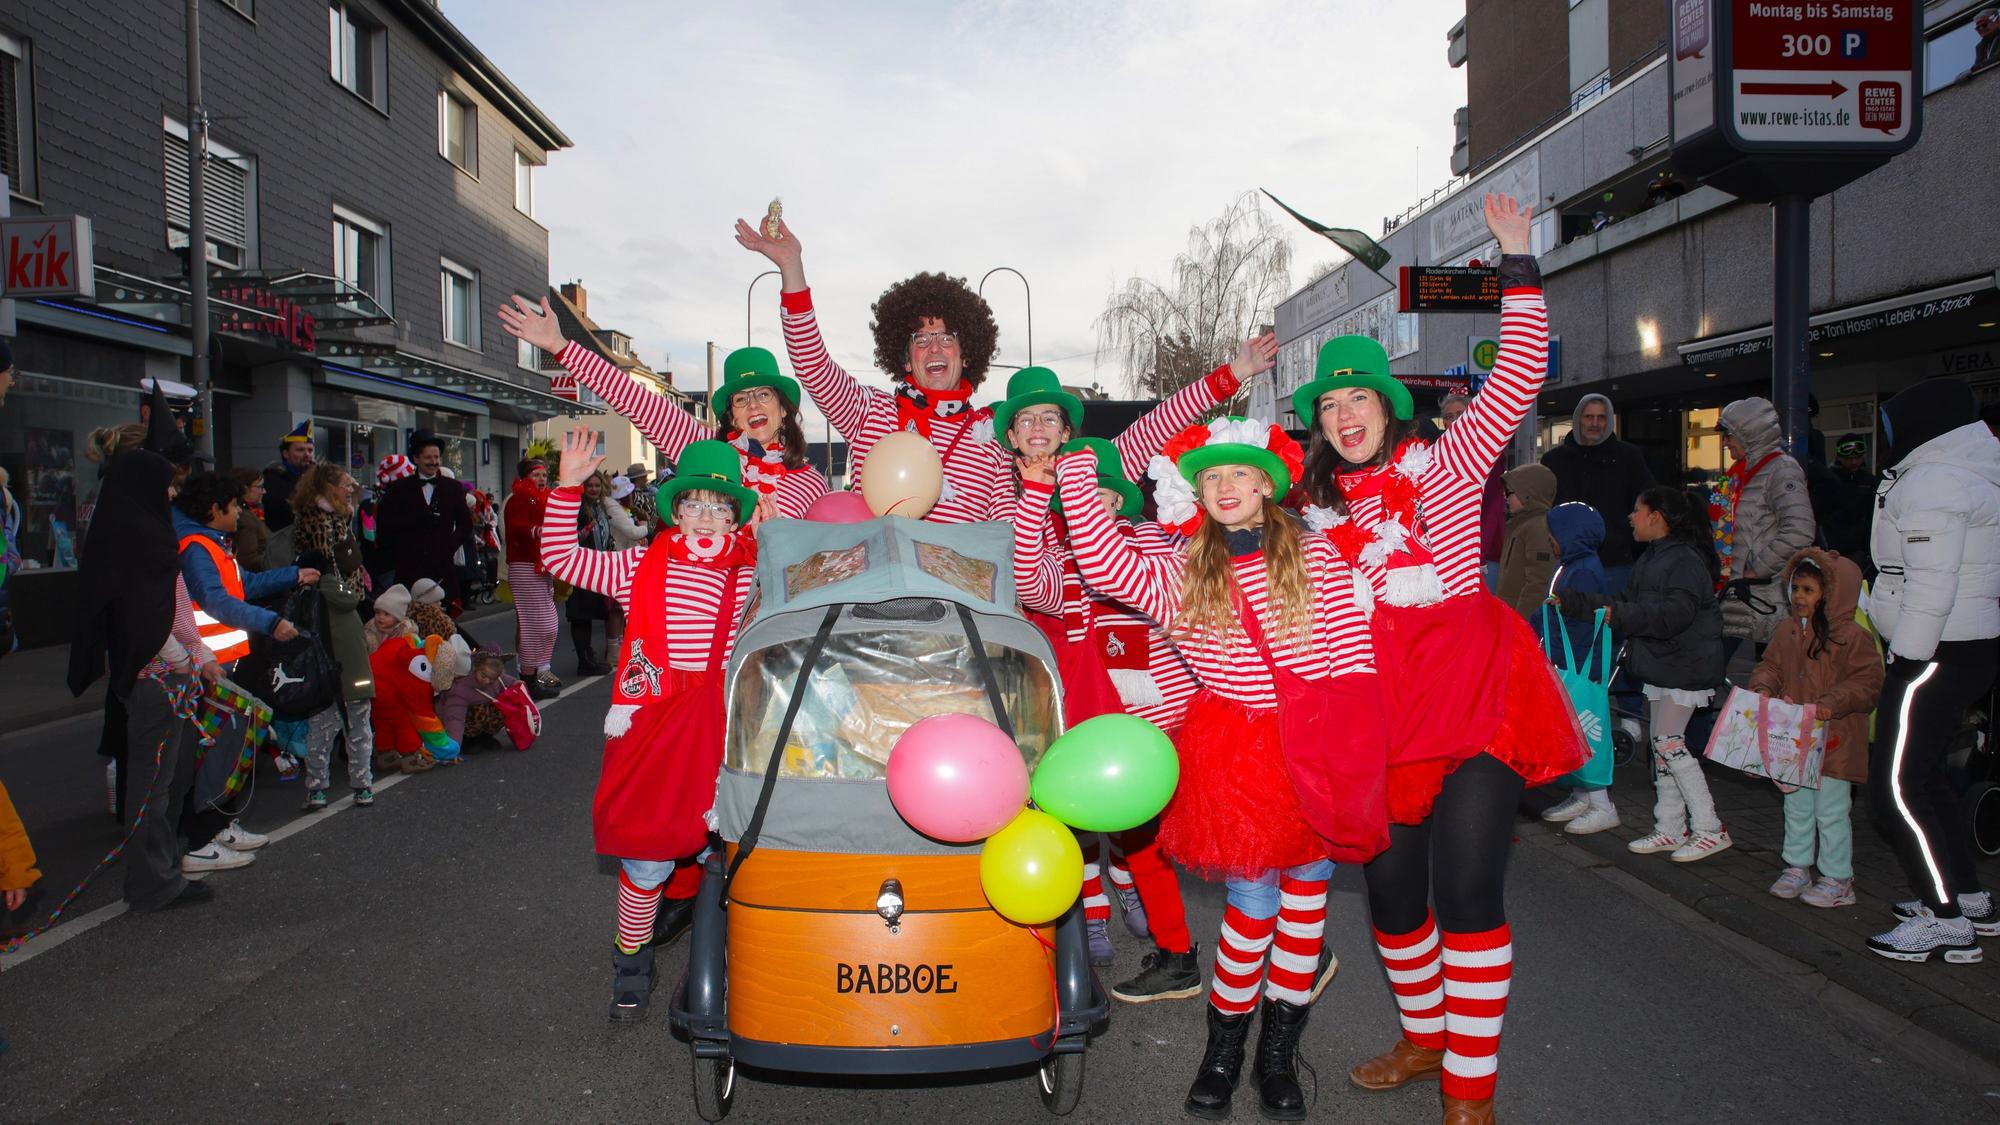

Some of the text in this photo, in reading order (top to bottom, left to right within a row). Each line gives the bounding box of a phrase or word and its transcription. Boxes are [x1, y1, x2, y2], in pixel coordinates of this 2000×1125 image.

[1750, 4, 1894, 21] Montag bis Samstag
[1781, 33, 1861, 57] 300 P
[1865, 88, 1895, 97] REWE
[1865, 98, 1895, 106] CENTER
[1740, 108, 1850, 126] www.rewe-istas.de
[8, 224, 70, 288] kik
[1738, 340, 1761, 354] Faber
[1824, 320, 1845, 338] Toni
[1846, 317, 1879, 334] Hosen
[1885, 306, 1916, 327] Lebek
[1923, 294, 1976, 318] Di-Strick
[1942, 351, 1994, 372] VERA
[551, 375, 577, 388] VIA
[837, 963, 958, 994] BABBOE
